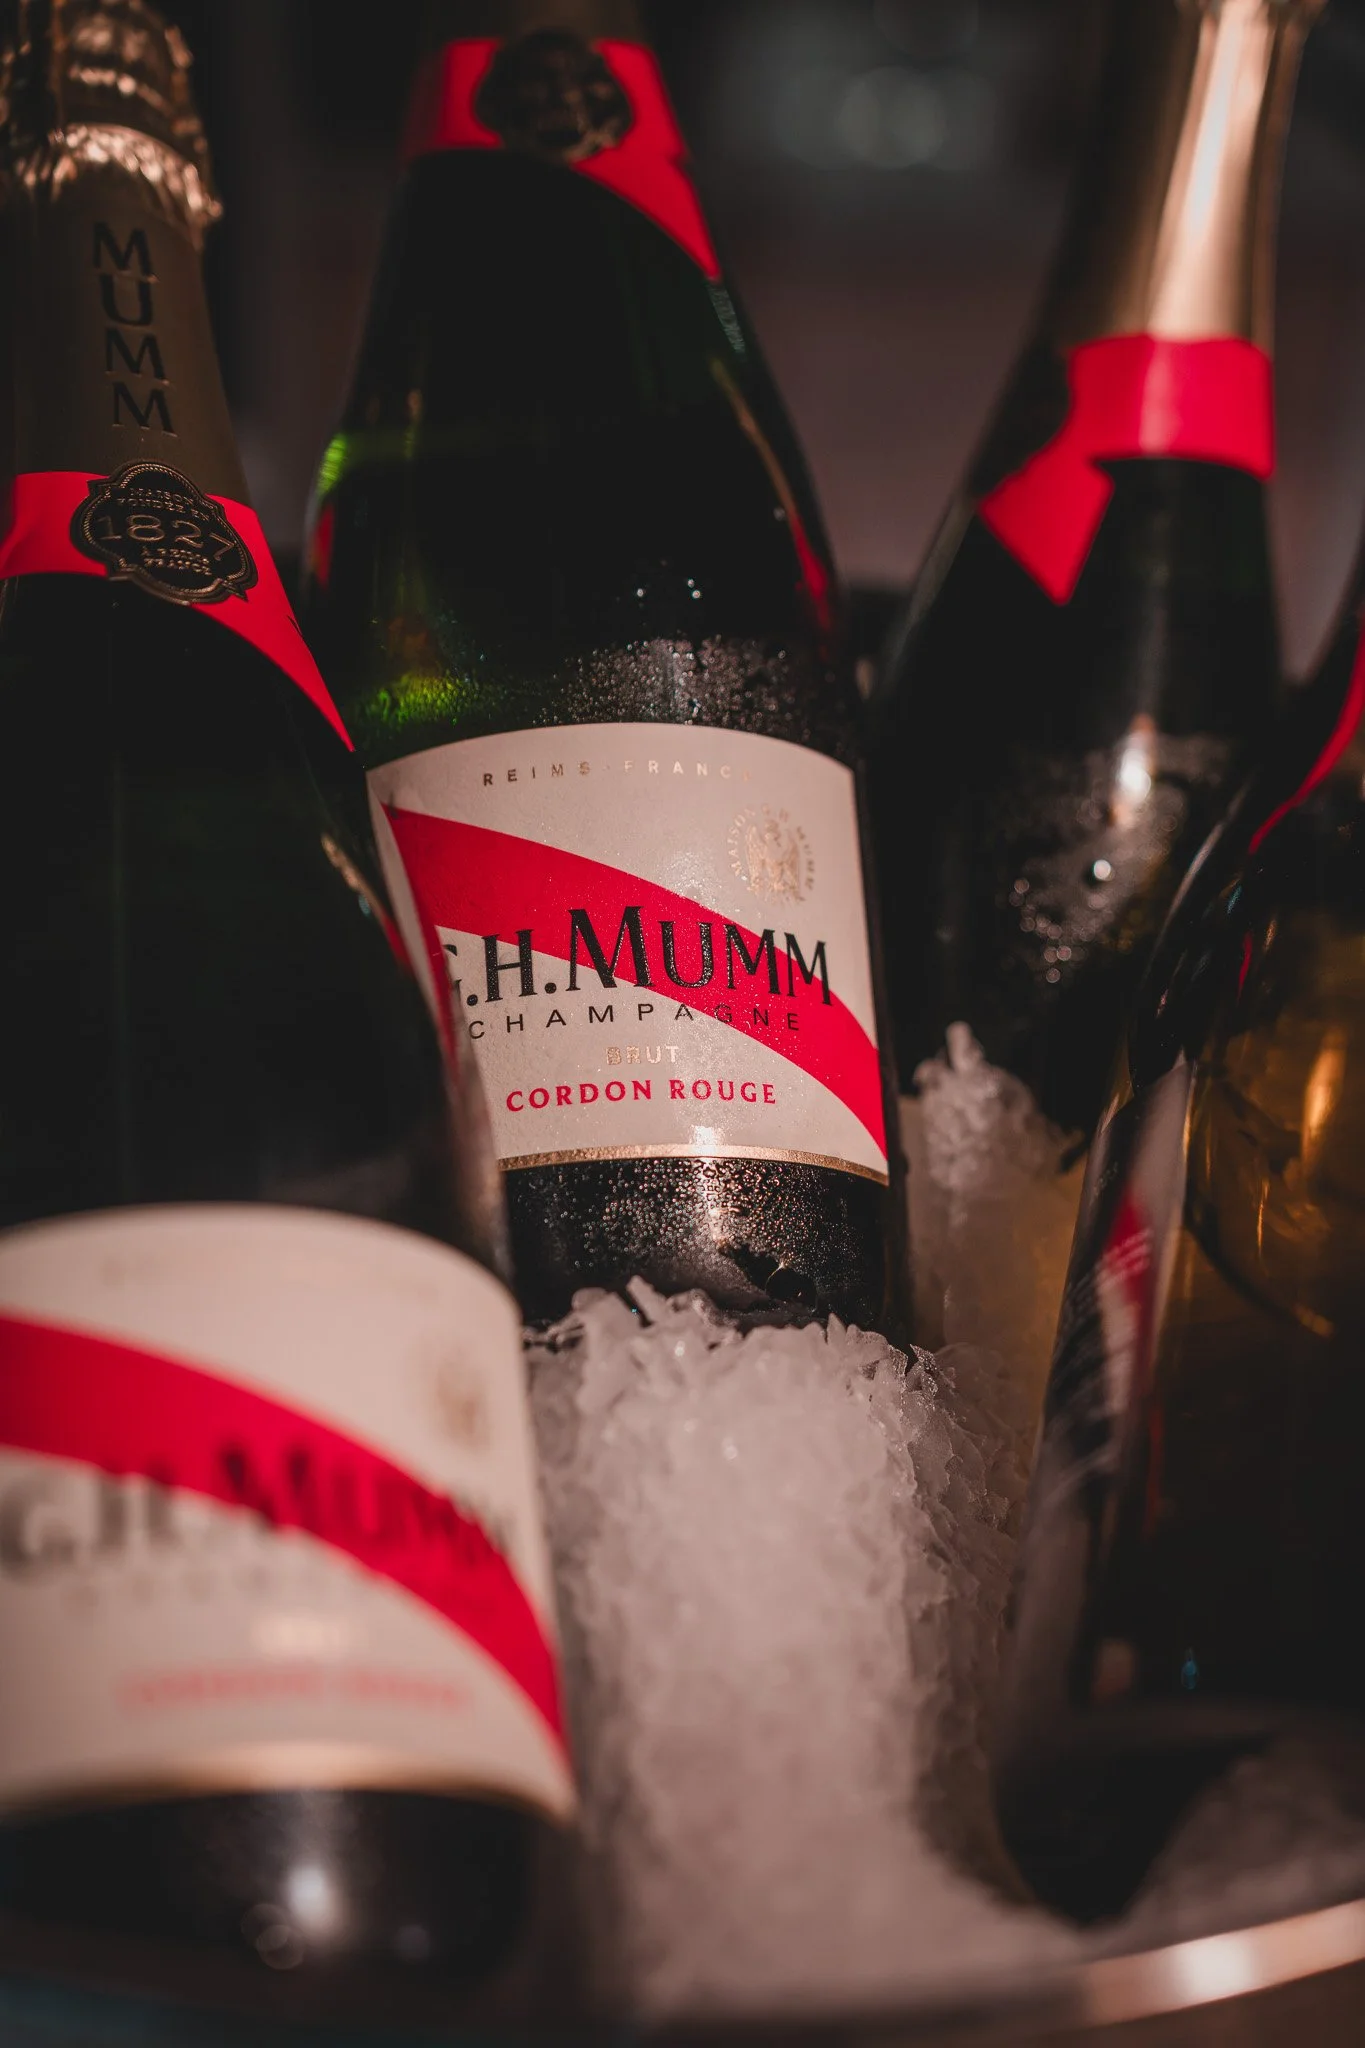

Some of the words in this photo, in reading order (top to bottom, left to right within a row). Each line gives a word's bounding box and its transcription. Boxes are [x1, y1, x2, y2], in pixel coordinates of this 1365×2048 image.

[93, 220, 179, 437] MUMM
[97, 514, 236, 561] 1827
[483, 761, 591, 787] REIMS
[468, 1003, 800, 1040] CHAMPAGNE
[606, 1045, 680, 1066] BRUT
[506, 1079, 652, 1112] CORDON
[669, 1079, 776, 1104] ROUGE
